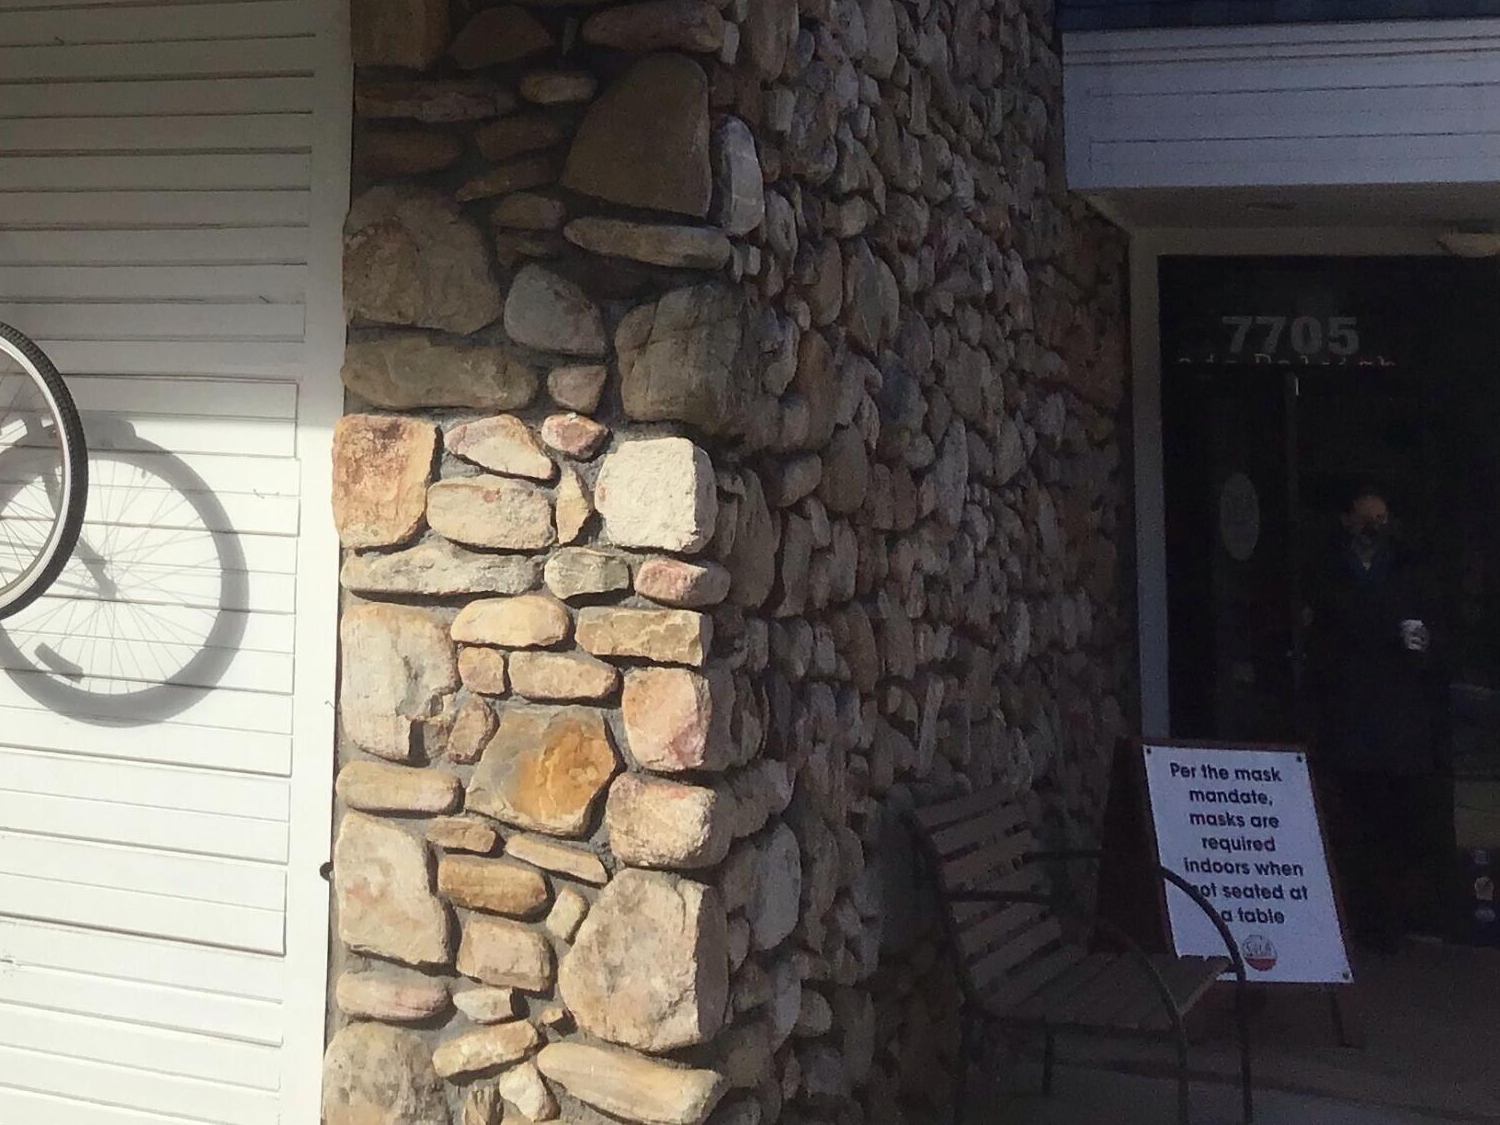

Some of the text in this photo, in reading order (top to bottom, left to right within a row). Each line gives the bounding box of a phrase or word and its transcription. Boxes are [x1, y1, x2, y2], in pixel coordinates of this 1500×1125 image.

[1221, 315, 1360, 356] 7705
[1169, 762, 1283, 782] Per the mask
[1189, 789, 1273, 806] mandate,
[1189, 812, 1280, 828] masks are
[1201, 836, 1277, 854] required
[1183, 857, 1304, 876] indoors when
[1222, 883, 1285, 900] seated
[1289, 885, 1308, 900] at
[1221, 907, 1285, 924] a table
